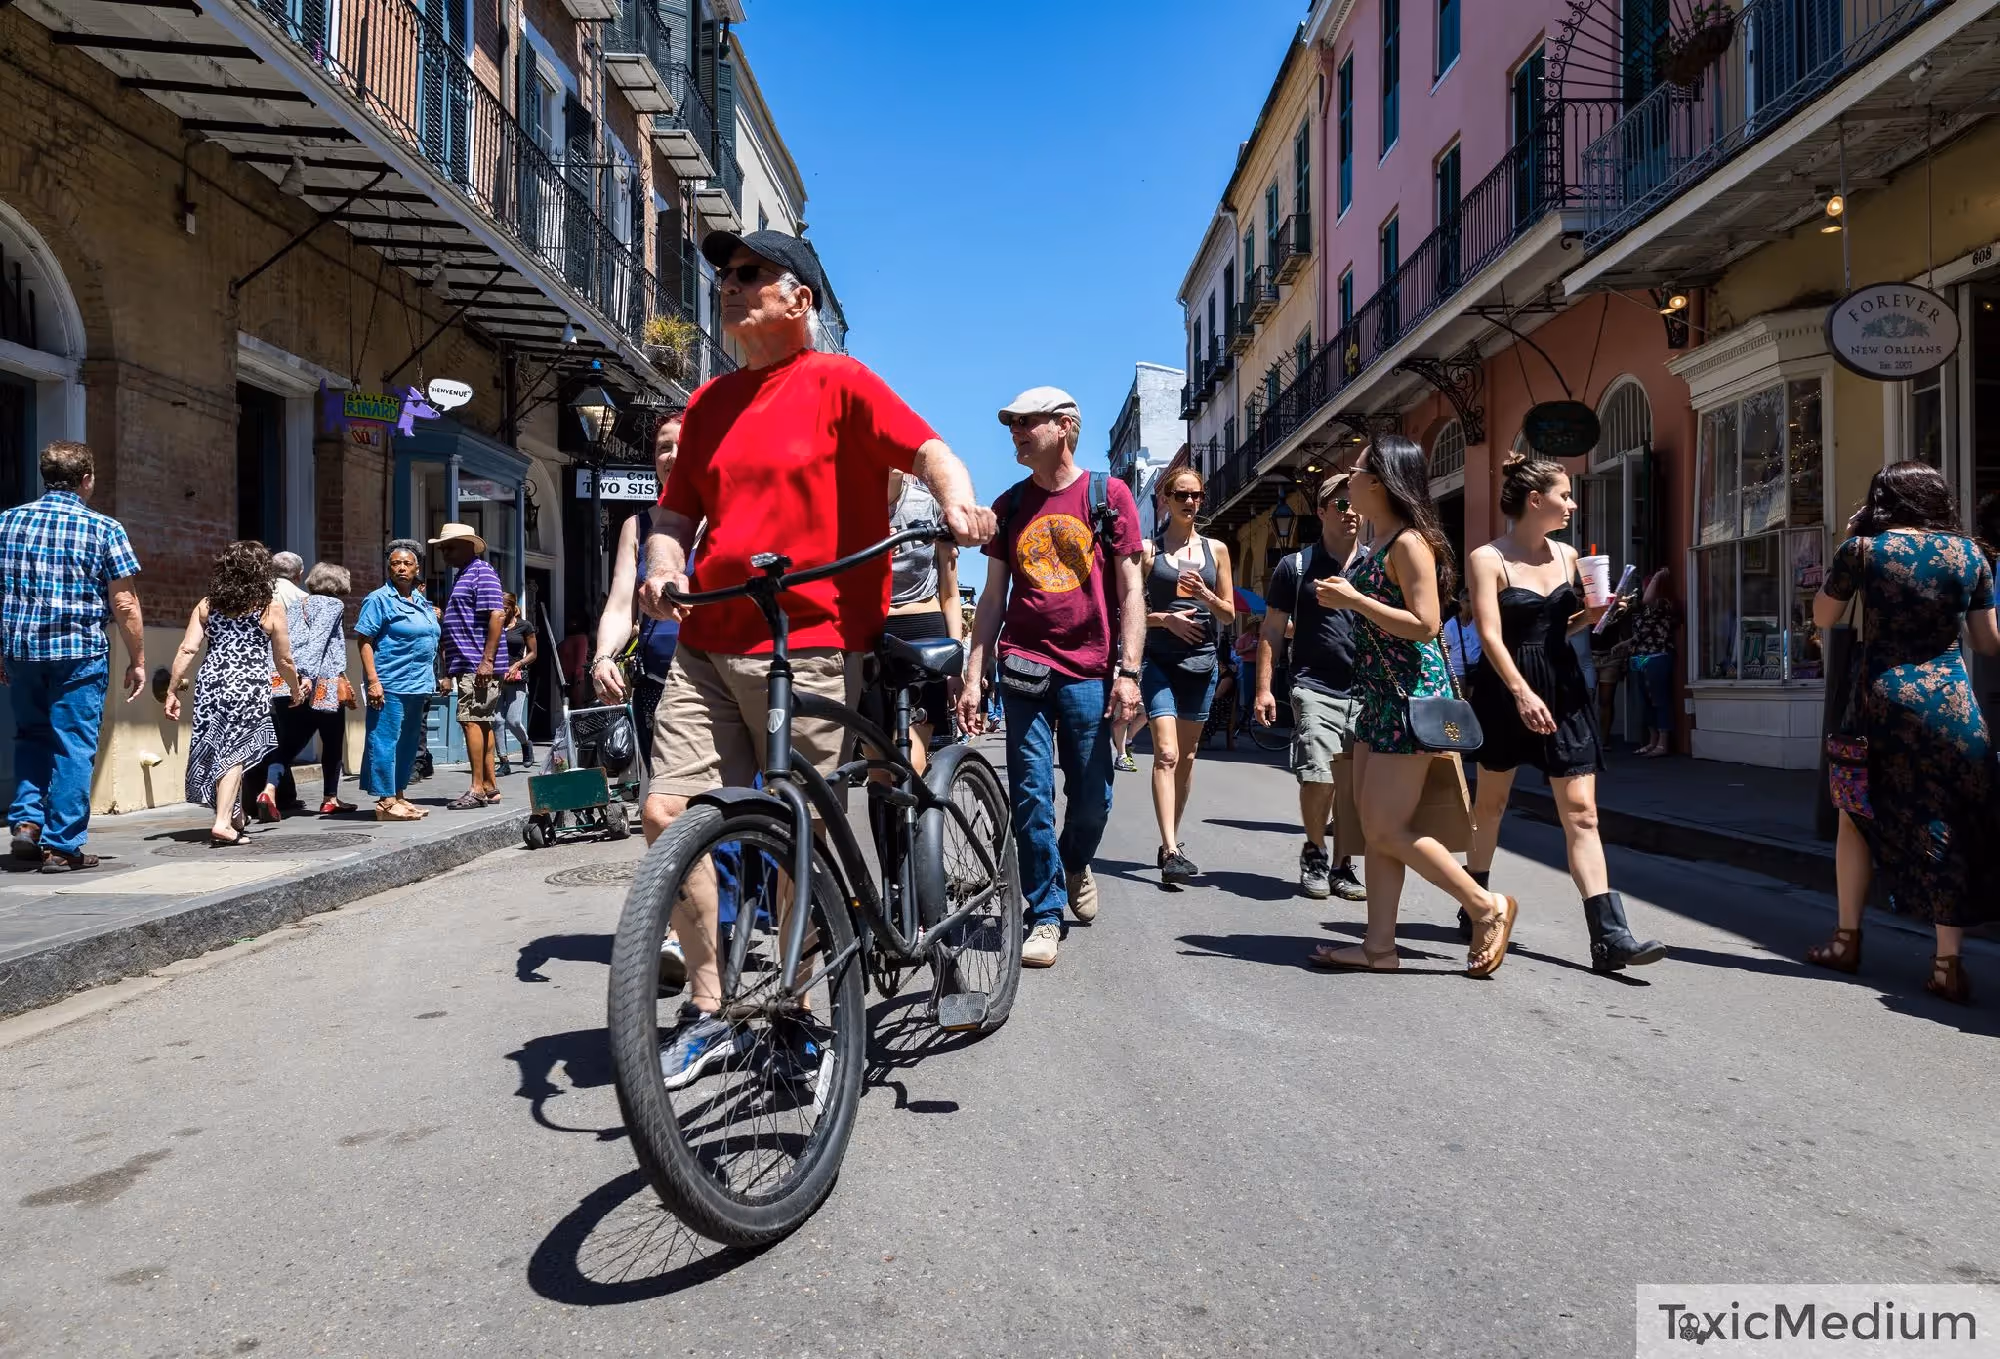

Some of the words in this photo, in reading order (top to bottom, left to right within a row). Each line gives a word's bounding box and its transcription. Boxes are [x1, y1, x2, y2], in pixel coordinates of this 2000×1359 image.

[1972, 246, 1992, 266] 608
[1848, 294, 1940, 325] FOREVER
[1850, 345, 1879, 355] NEW
[1884, 344, 1943, 355] ORLEANS
[346, 401, 398, 420] RINARD
[626, 471, 656, 481] Cou
[627, 483, 657, 495] SIS
